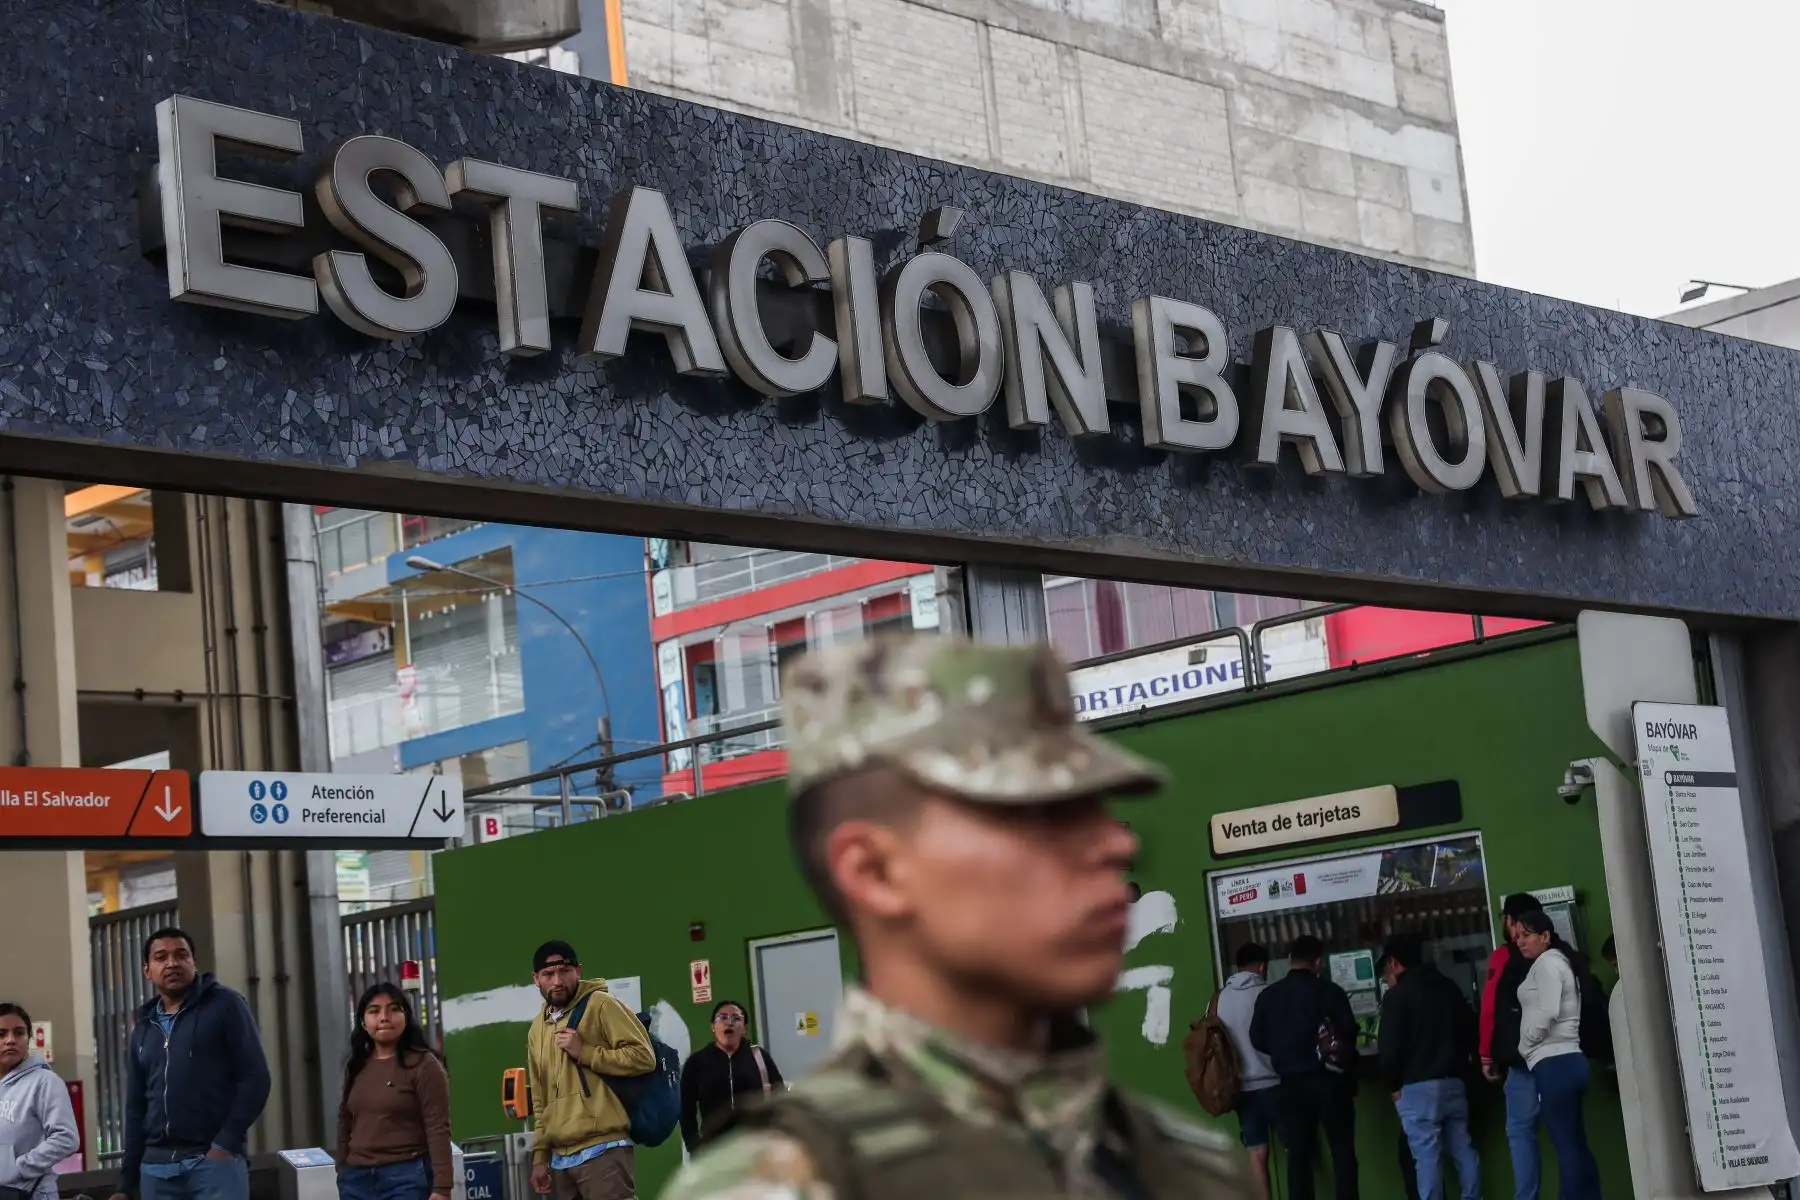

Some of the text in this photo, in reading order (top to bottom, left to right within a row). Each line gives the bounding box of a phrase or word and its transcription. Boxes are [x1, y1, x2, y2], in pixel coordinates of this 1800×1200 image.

[156, 94, 1700, 520] ESTACIÓN BAYÓVAR
[1645, 717, 1698, 740] BAYÓVAR
[24, 790, 39, 807] El
[42, 790, 111, 808] Salvador
[311, 783, 375, 801] Atención
[302, 806, 386, 825] Preferencial
[1221, 804, 1361, 840] Venta de tarjetas
[486, 817, 498, 836] B
[464, 1169, 475, 1181] O
[467, 1186, 491, 1199] CIAL
